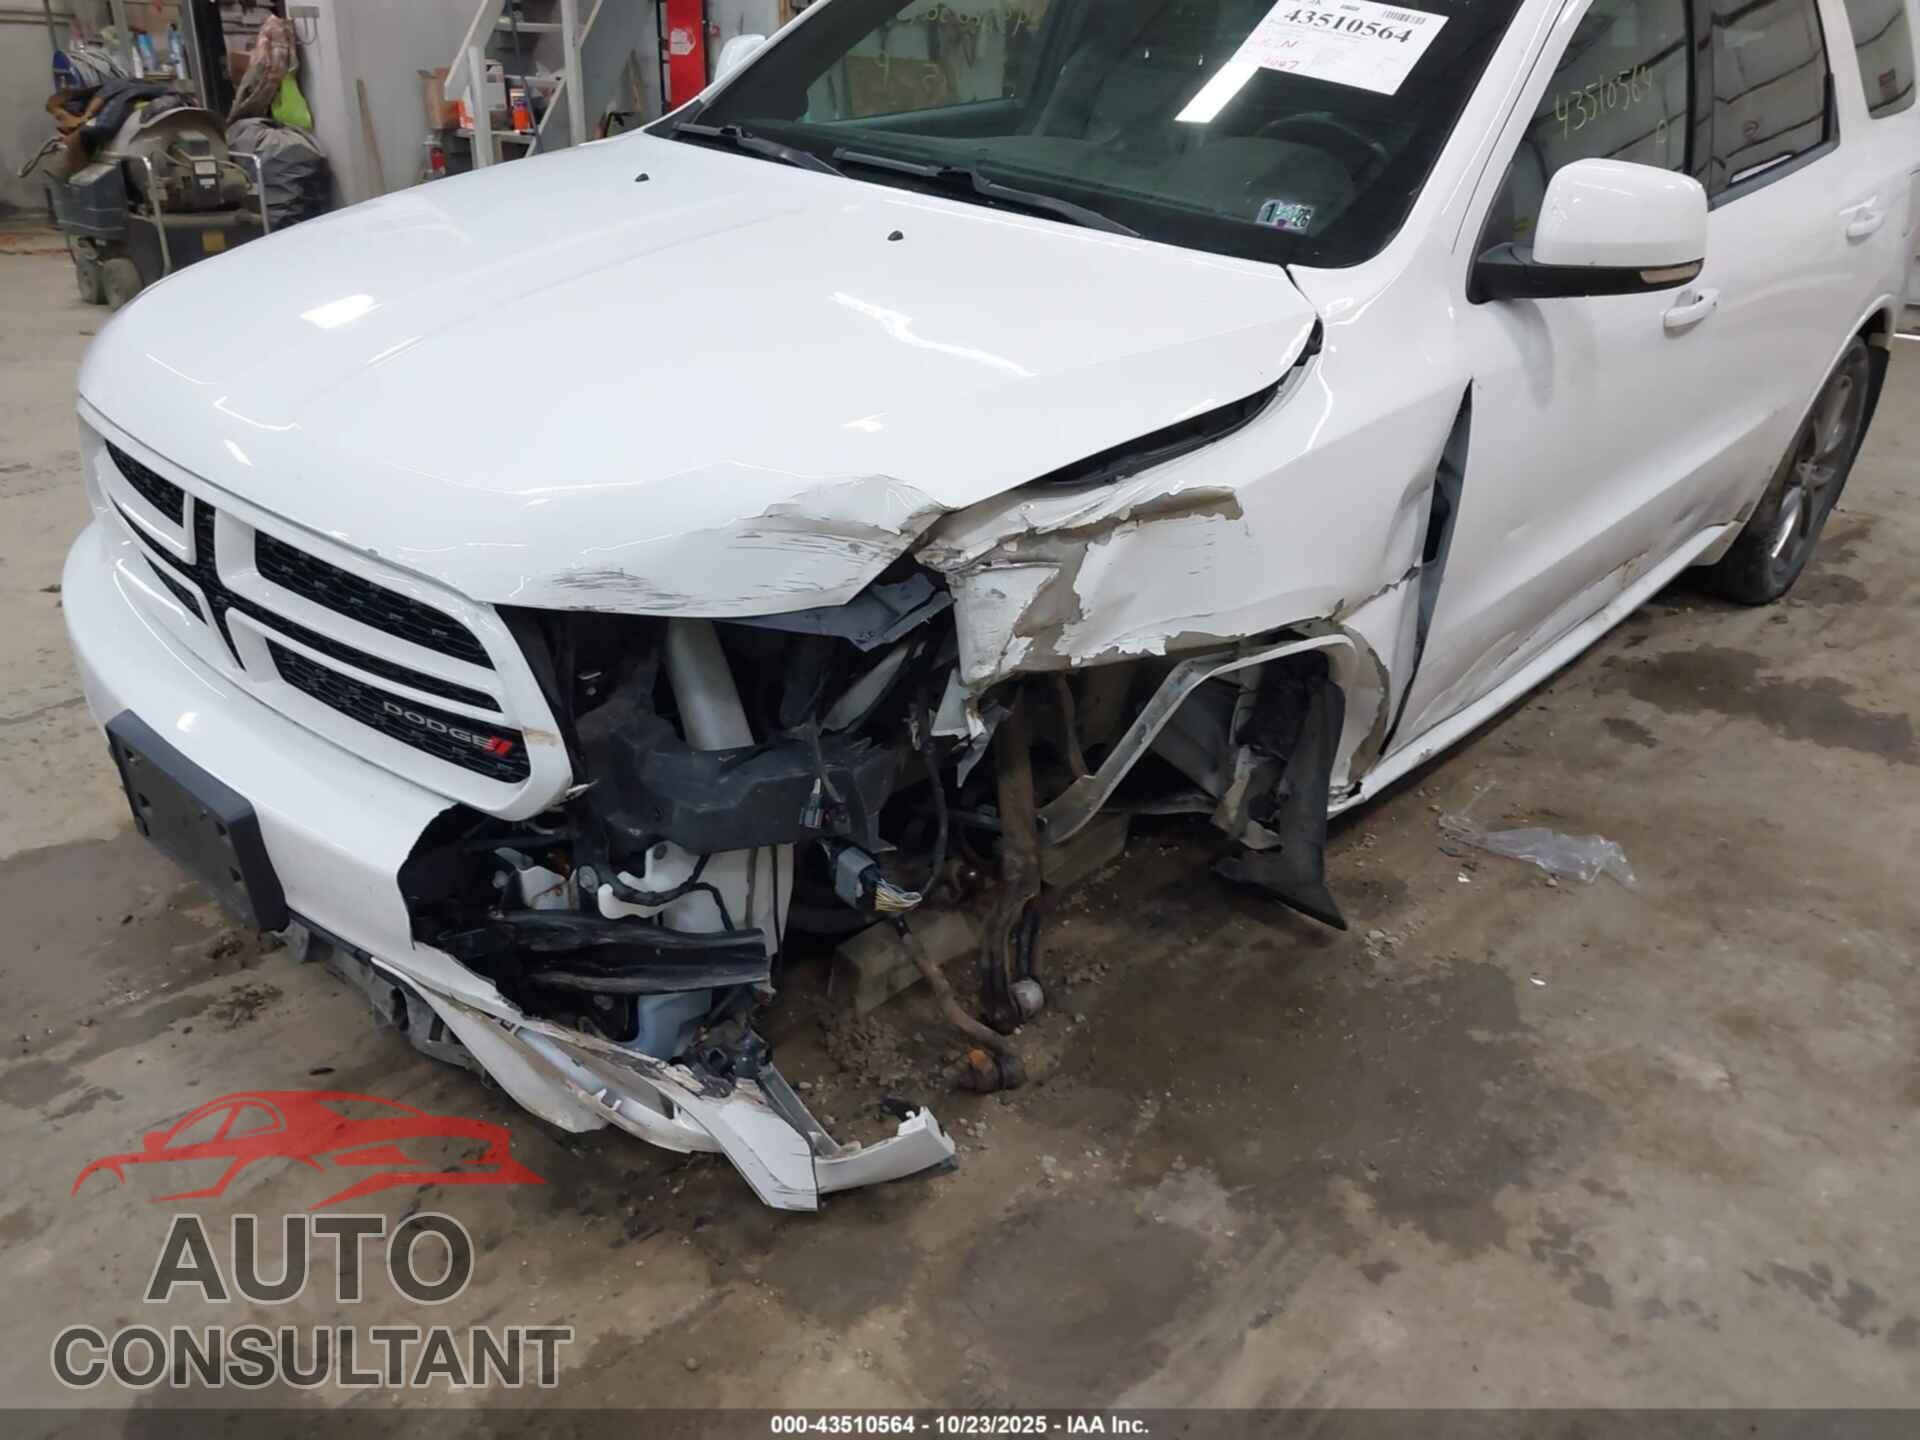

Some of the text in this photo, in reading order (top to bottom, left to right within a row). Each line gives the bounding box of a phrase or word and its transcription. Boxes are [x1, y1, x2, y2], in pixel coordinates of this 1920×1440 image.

[1283, 8, 1413, 43] 43510564
[1555, 64, 1652, 140] 43510564
[383, 701, 495, 751] DODGE
